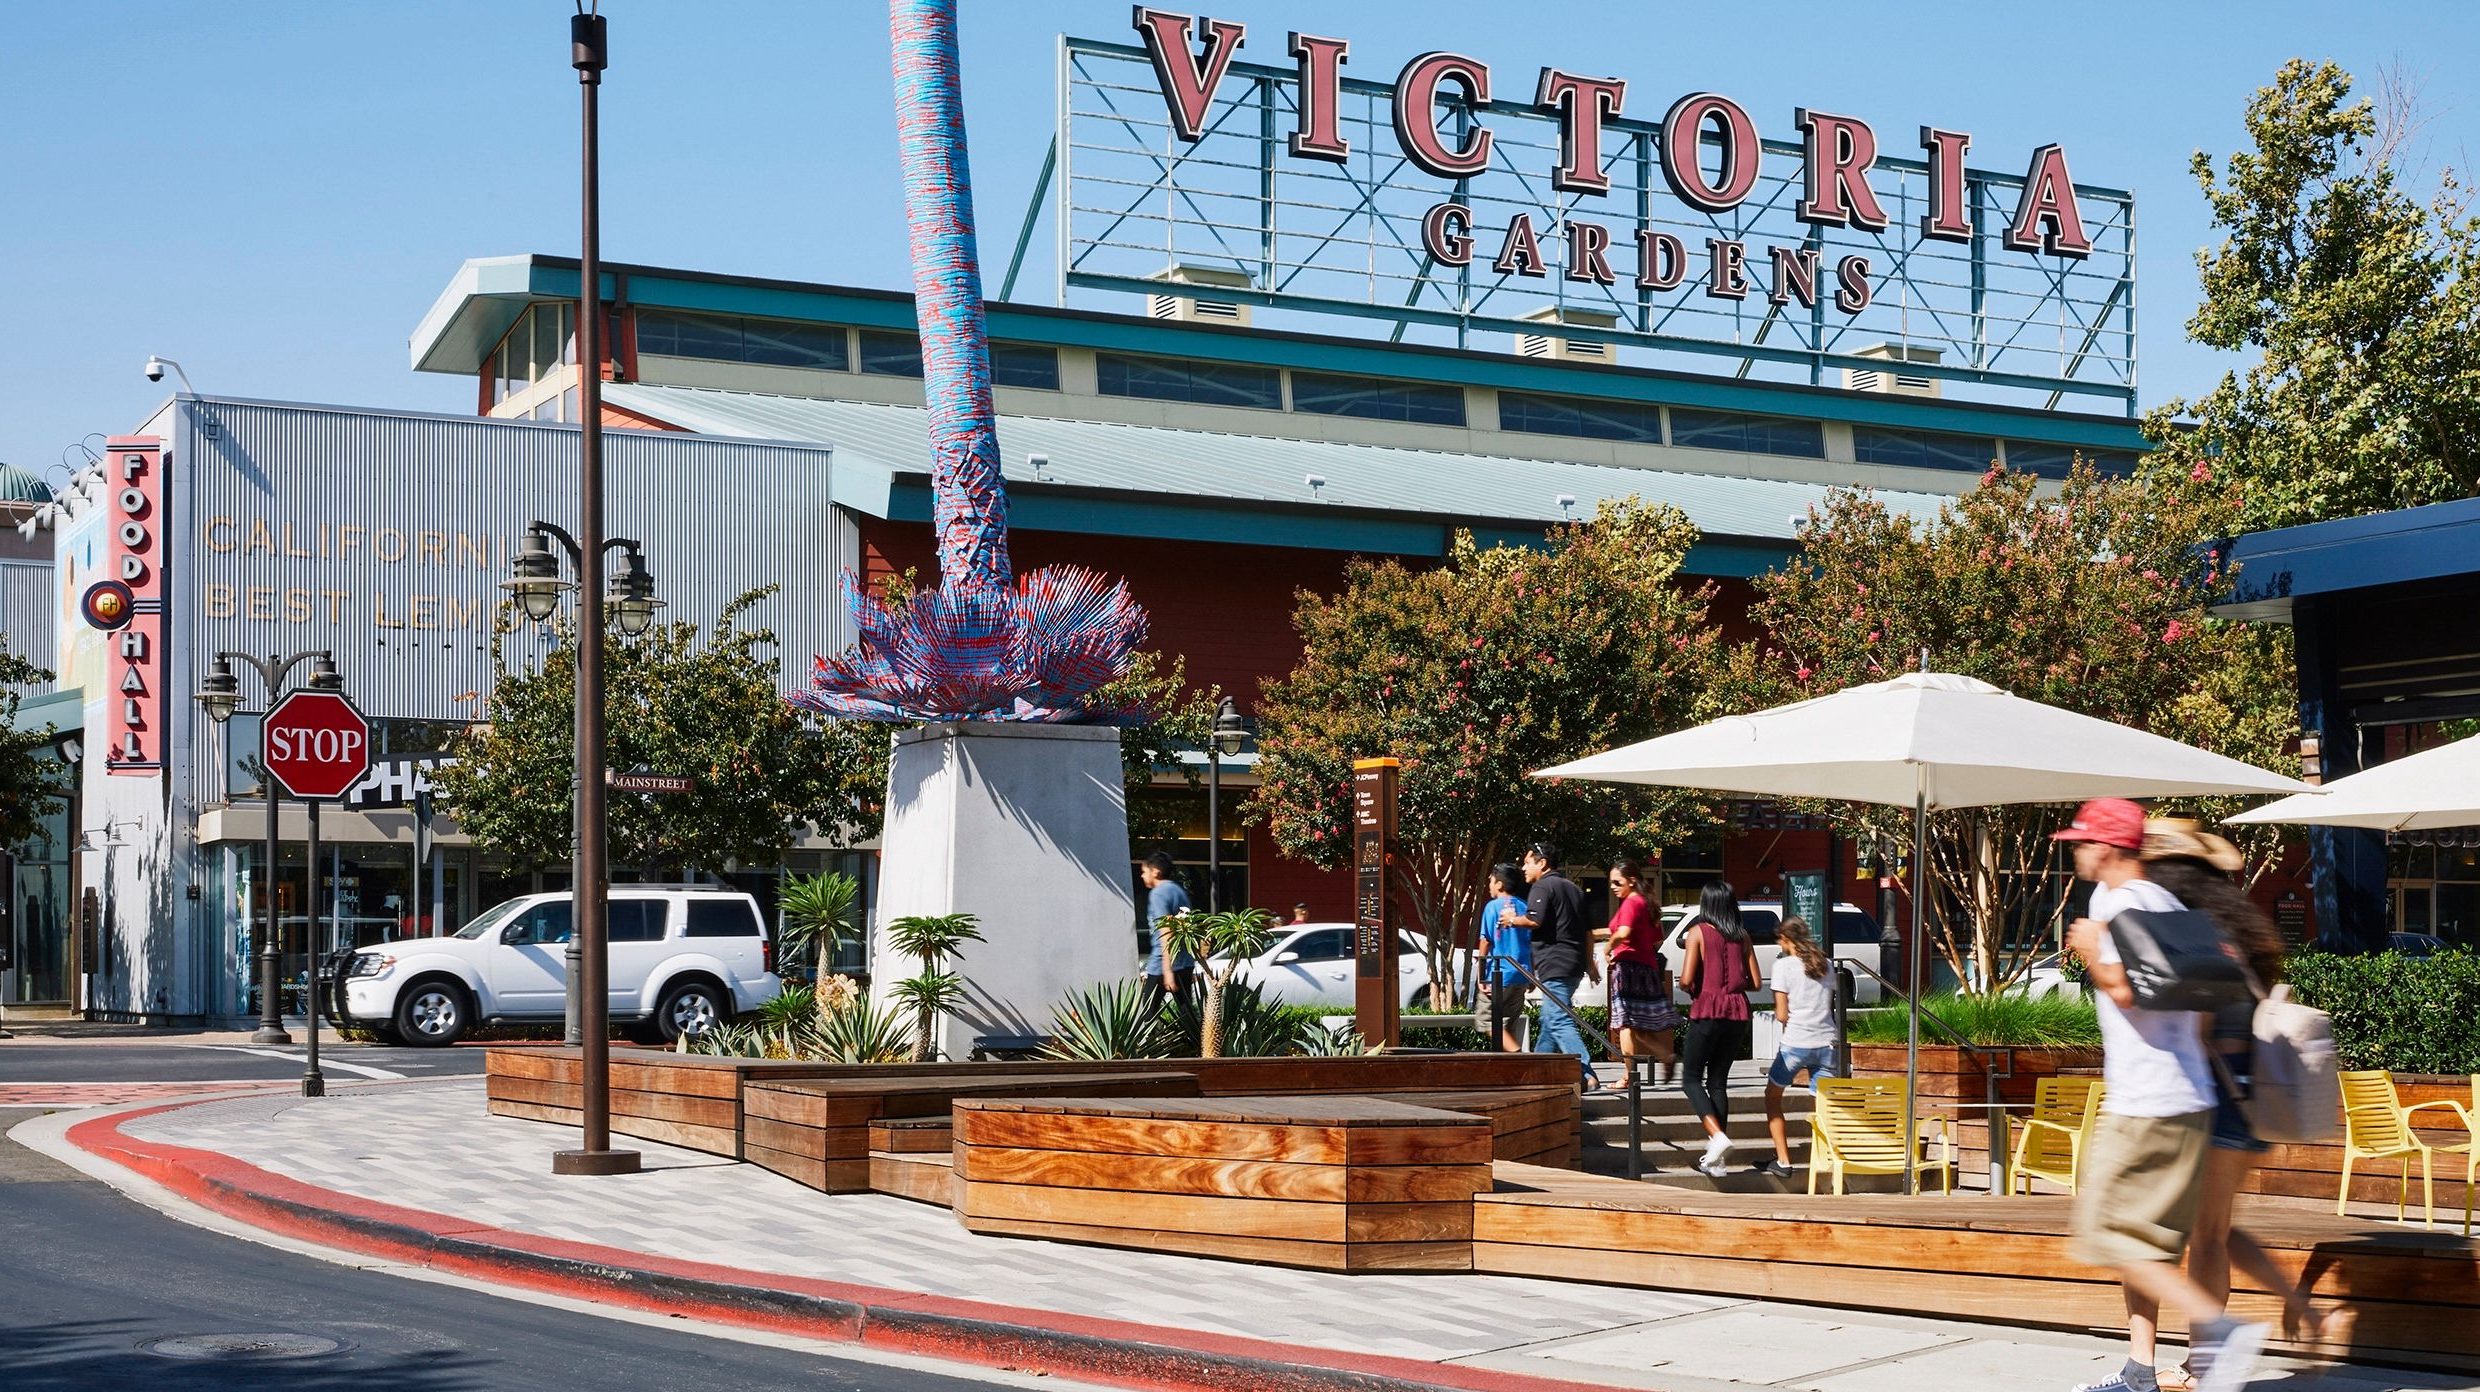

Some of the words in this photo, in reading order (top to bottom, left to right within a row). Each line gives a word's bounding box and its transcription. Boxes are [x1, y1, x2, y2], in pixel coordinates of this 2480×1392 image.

[1133, 5, 2093, 258] VICTORIA
[1421, 202, 1872, 314] GARDENS
[119, 454, 147, 584] FOOD
[102, 597, 118, 613] FH
[206, 583, 350, 625] BEST
[120, 631, 146, 760] HALL
[271, 726, 362, 763] STOP
[1794, 884, 1818, 901] Hours
